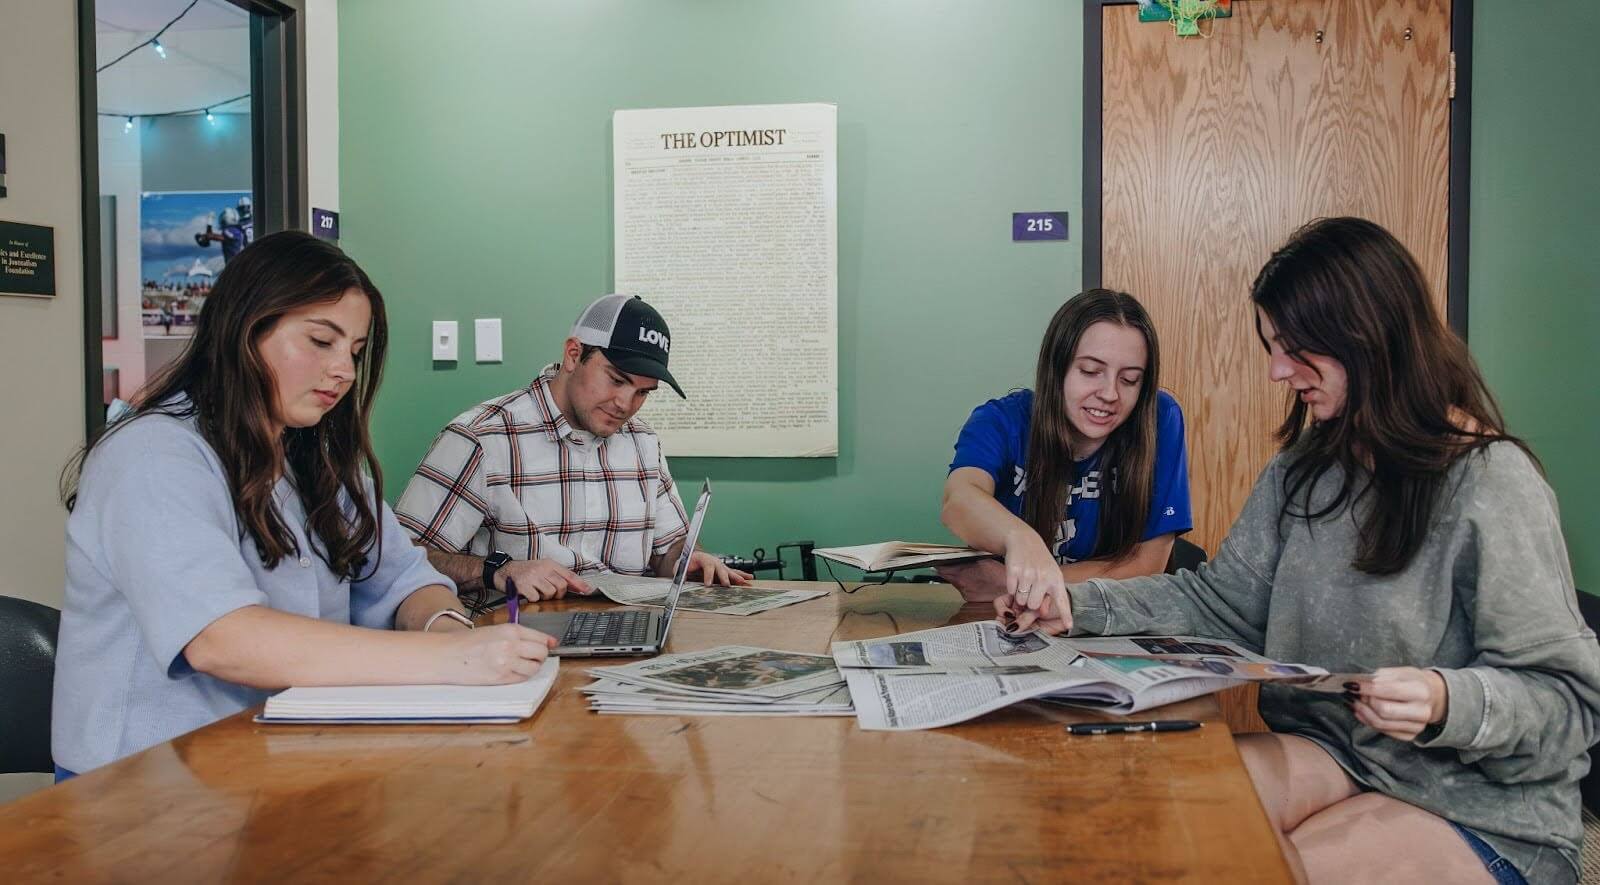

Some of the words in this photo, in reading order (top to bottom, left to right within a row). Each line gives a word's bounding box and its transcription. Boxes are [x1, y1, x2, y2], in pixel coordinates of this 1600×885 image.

[661, 133, 697, 150] THE
[700, 129, 786, 148] OPTIMIST
[320, 215, 333, 229] 217
[1027, 218, 1053, 232] 215
[8, 258, 37, 267] Journalism
[20, 251, 46, 260] Excellence
[5, 266, 34, 275] Foundation
[639, 326, 669, 353] LOVE
